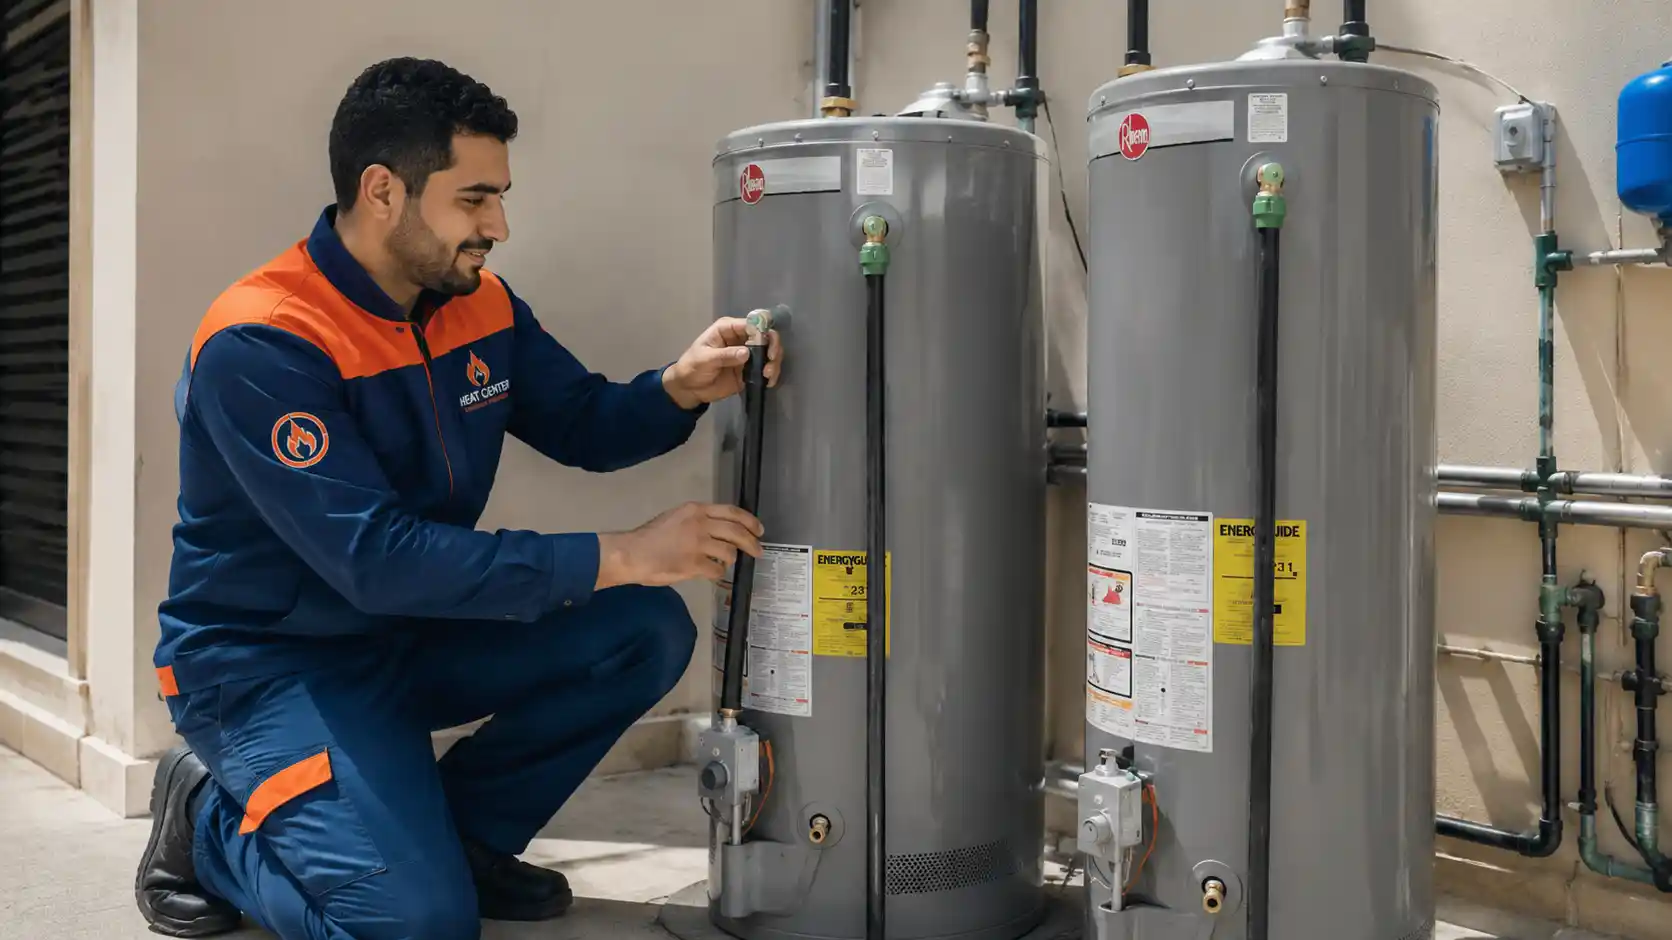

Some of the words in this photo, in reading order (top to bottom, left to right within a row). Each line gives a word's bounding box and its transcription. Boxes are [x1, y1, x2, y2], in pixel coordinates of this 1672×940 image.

[459, 391, 480, 407] HEAT
[818, 555, 886, 566] ENERGYGU
[851, 585, 868, 596] 23
